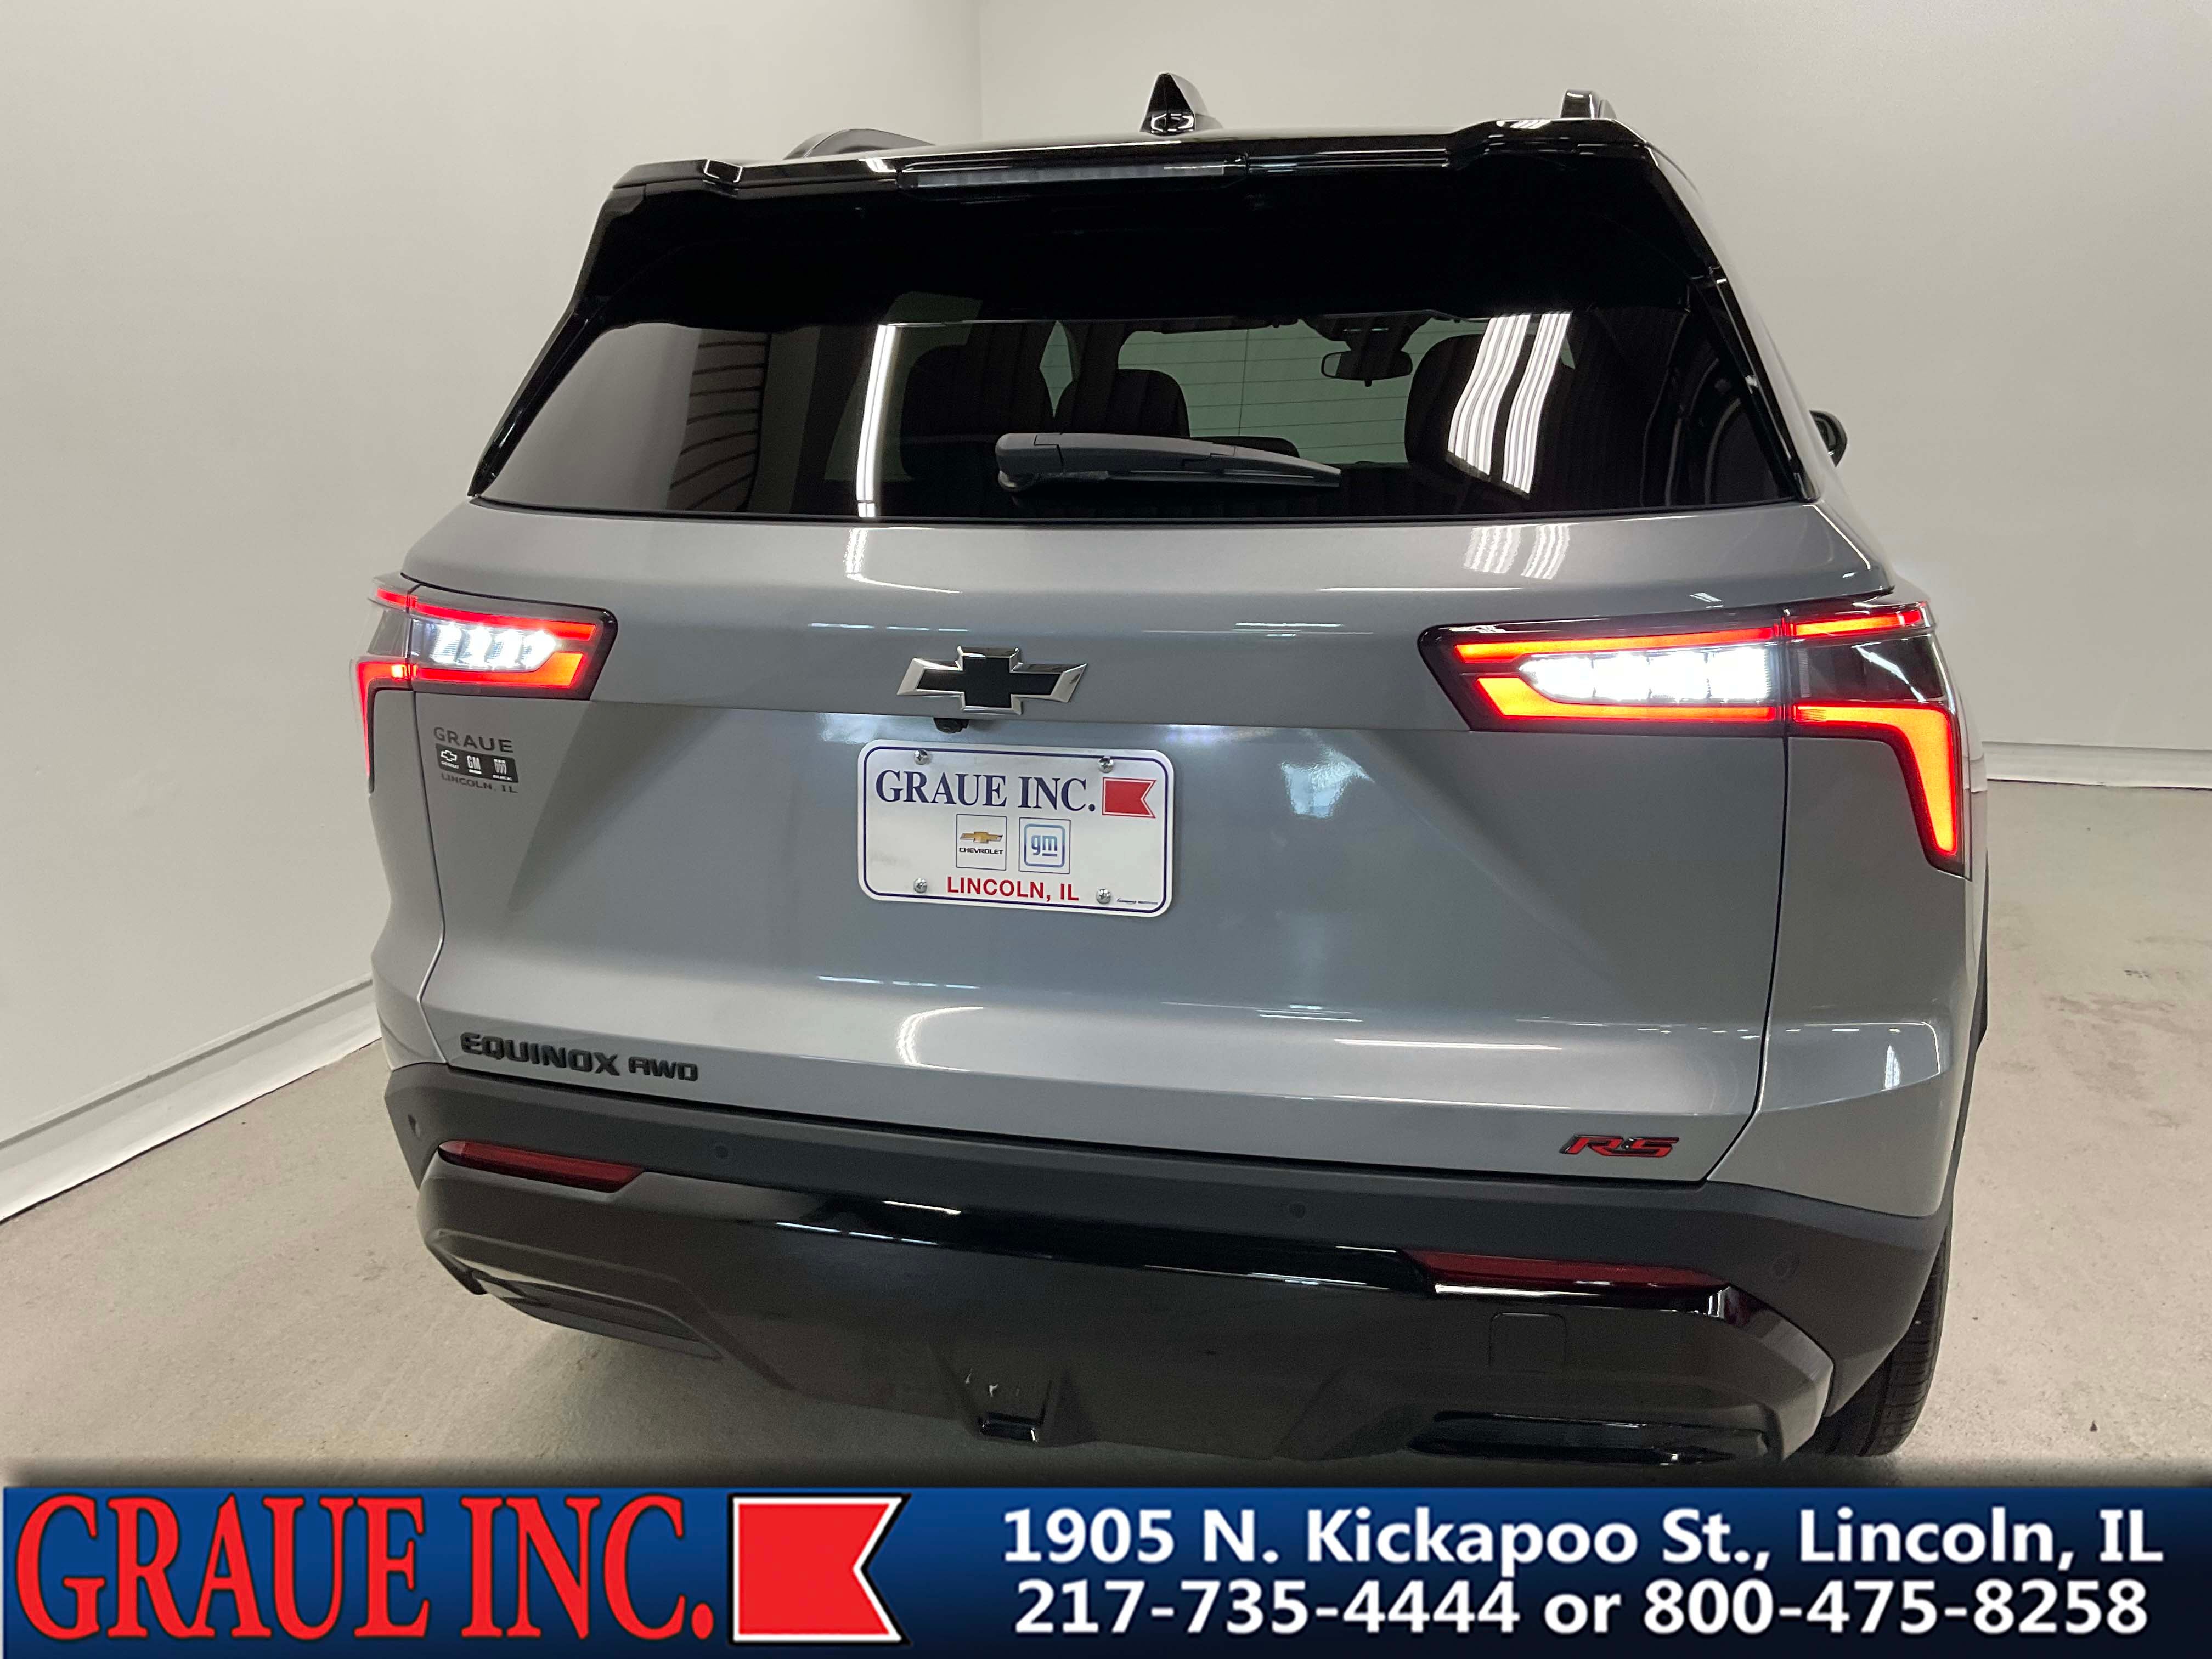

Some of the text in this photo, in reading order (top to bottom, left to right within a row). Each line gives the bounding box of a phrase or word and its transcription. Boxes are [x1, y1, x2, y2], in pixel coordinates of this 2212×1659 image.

[433, 726, 514, 753] GRAUE
[501, 785, 518, 793] IL
[876, 769, 1096, 812] GRAUE INC.
[947, 876, 1079, 902] LINCOLN, IL
[460, 1032, 699, 1082] EQUINOX AWD
[1558, 1134, 1680, 1158] RS
